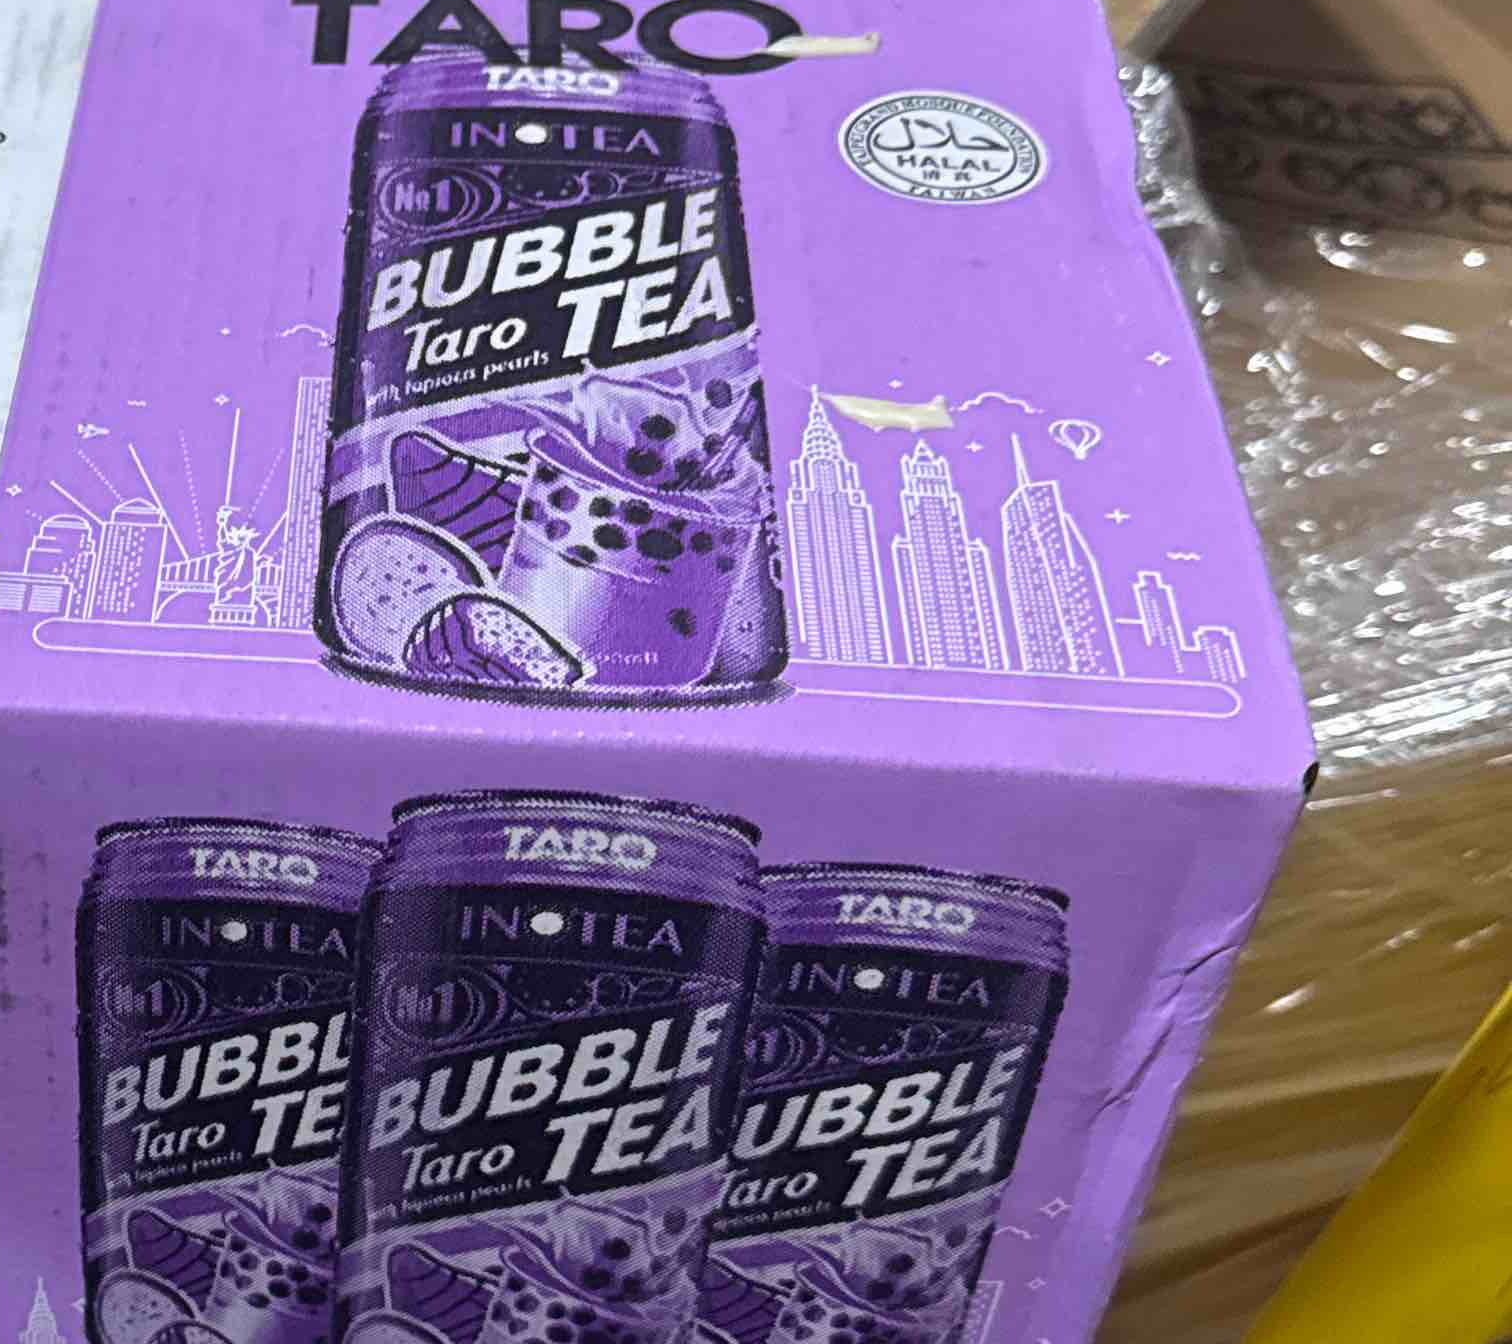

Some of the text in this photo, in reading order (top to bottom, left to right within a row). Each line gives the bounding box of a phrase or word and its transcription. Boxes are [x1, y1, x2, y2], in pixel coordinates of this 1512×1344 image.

[482, 66, 619, 96] TARO
[896, 154, 1002, 173] HALAL
[366, 187, 721, 333] BUBBLE
[404, 256, 734, 374] Taro TEA
[189, 846, 320, 887] TARO
[502, 825, 658, 872] TARO
[834, 893, 976, 936] TARO
[102, 1010, 352, 1128] BUBBL
[368, 1001, 733, 1151] BUBBLE
[732, 1044, 1028, 1161] UBBLE
[131, 1080, 350, 1164] Taro TE
[401, 1084, 714, 1193] Taro TEA
[841, 1117, 1003, 1210] TEA
